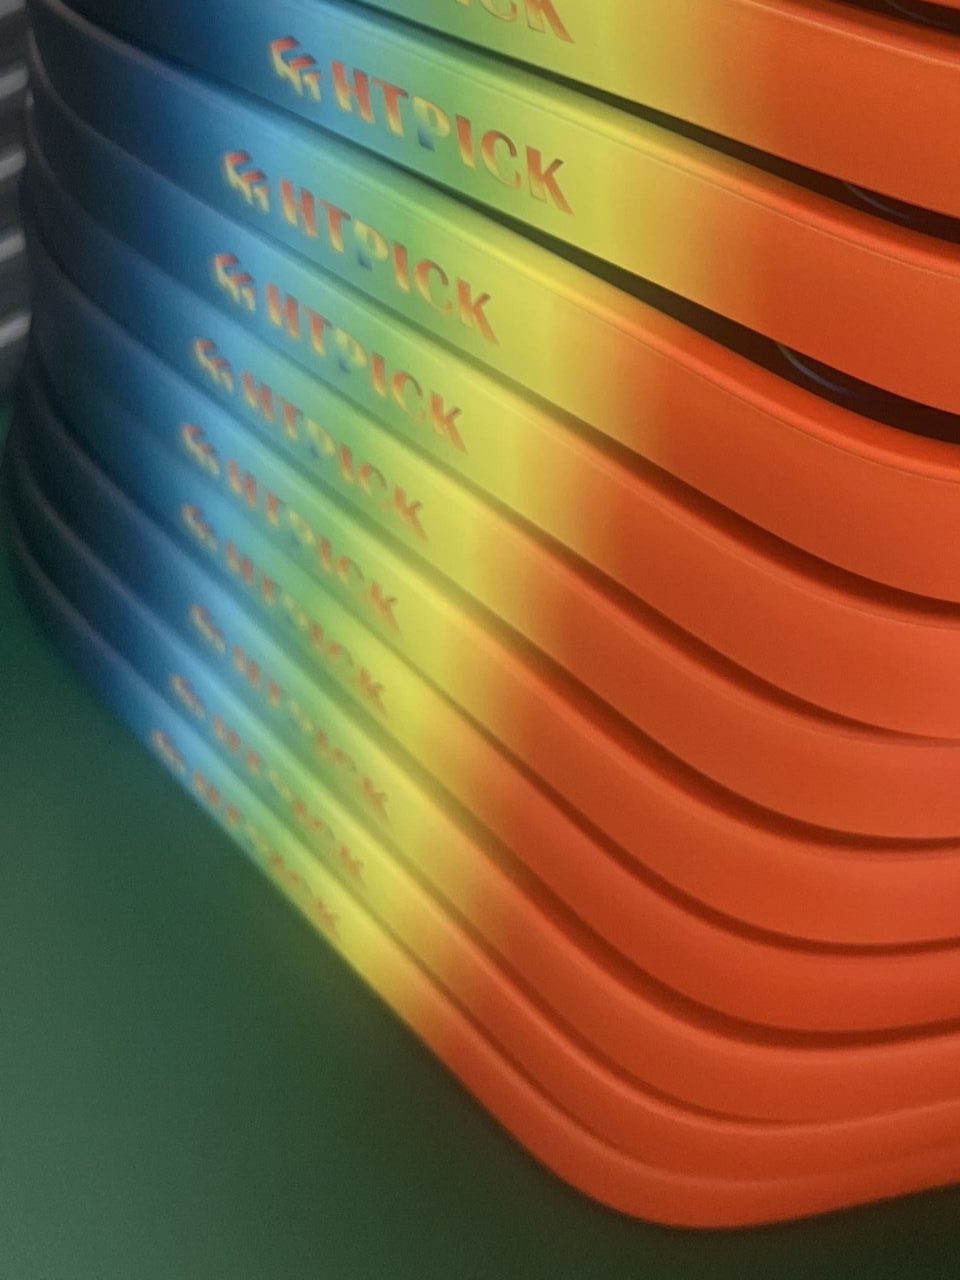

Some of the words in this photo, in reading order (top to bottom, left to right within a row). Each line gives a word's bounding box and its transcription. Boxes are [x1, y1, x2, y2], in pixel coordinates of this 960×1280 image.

[331, 59, 575, 216] HTPICK
[279, 178, 500, 346] HTPICK
[266, 283, 469, 456] HTPICK
